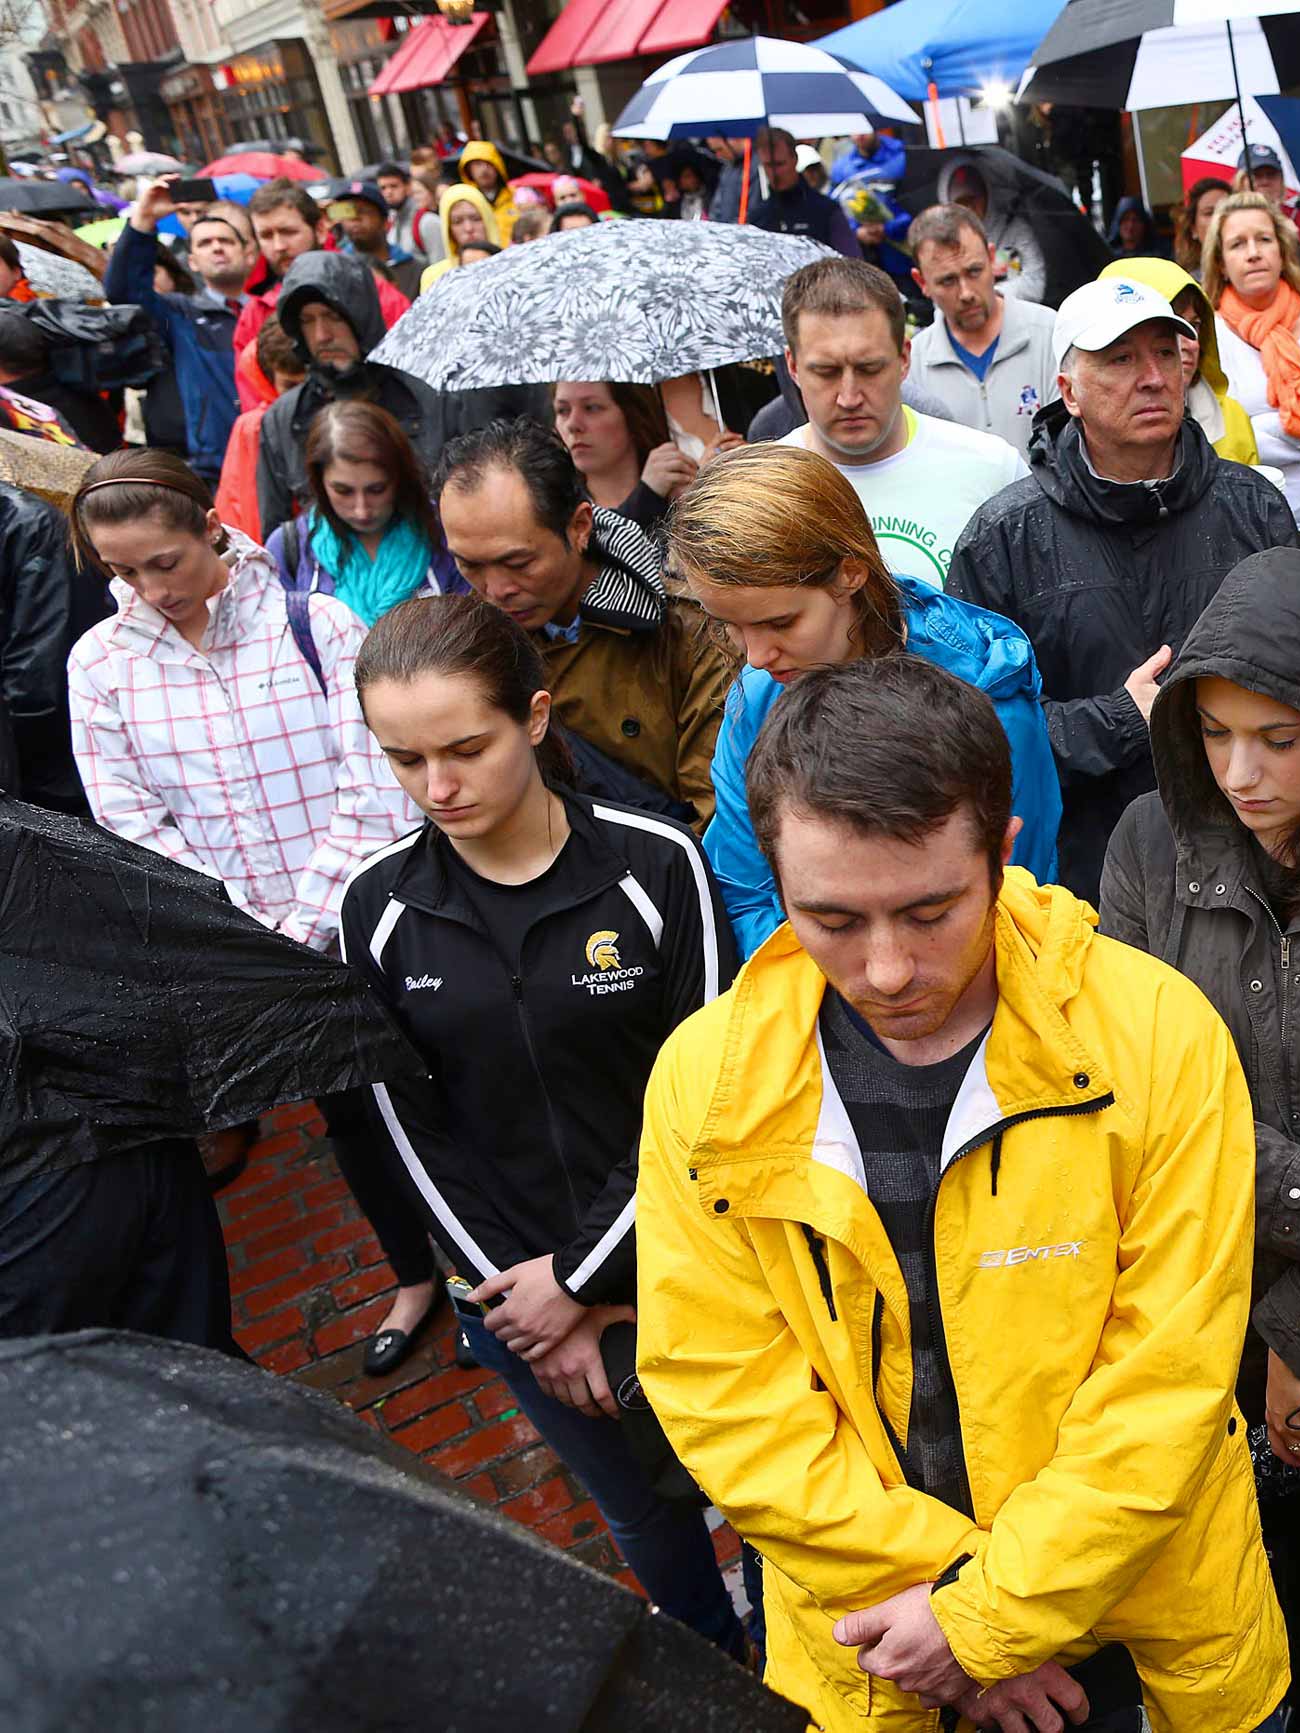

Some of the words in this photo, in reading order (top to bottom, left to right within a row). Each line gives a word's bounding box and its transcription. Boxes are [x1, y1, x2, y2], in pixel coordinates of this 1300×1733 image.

[872, 516, 937, 548] UNNING
[404, 974, 443, 991] Bailey
[571, 966, 644, 985] LAKEWOOD
[586, 980, 634, 995] TENNIS
